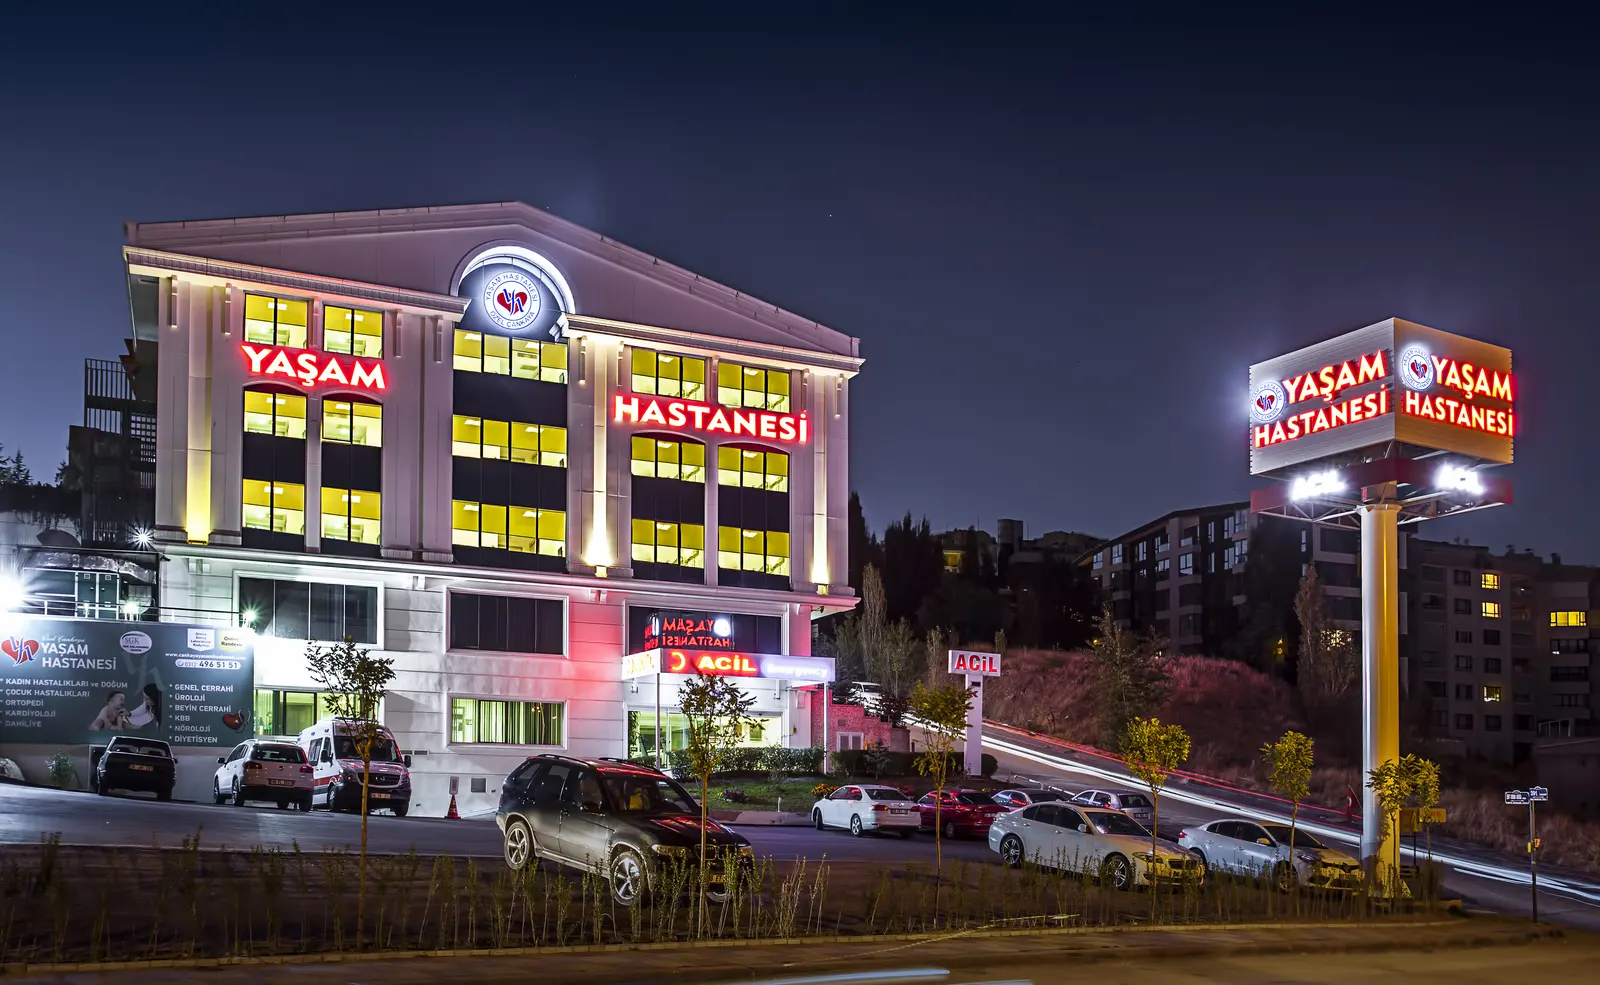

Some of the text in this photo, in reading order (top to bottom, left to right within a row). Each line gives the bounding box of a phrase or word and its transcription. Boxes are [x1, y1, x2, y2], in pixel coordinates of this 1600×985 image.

[241, 345, 386, 389] YAŞAM
[1282, 350, 1386, 402] YAŞAM
[1431, 355, 1512, 401] YAŞAM
[1254, 384, 1388, 448] HASTANESİ
[1405, 390, 1514, 436] HASTANESİ
[613, 395, 808, 443] HASTANESİ
[124, 636, 140, 644] SGK
[41, 643, 88, 656] YAŞAM
[42, 657, 116, 670] HASTANESİ
[697, 654, 757, 672] ACİL
[33, 679, 89, 687] HASTALIKLARI
[101, 680, 128, 688] DOĞUM
[201, 684, 234, 692] CERRAHİ
[5, 689, 90, 697] ÇOCUK HASTALIKLARI
[174, 693, 206, 701] ÜROLOJİ
[5, 698, 44, 707] ORTOPEDİ
[174, 704, 198, 712] BEYİN
[5, 709, 56, 717] KARDİYOLOJİ
[5, 719, 42, 727] DAHİLİYE
[174, 735, 218, 743] DİYETİSYEN
